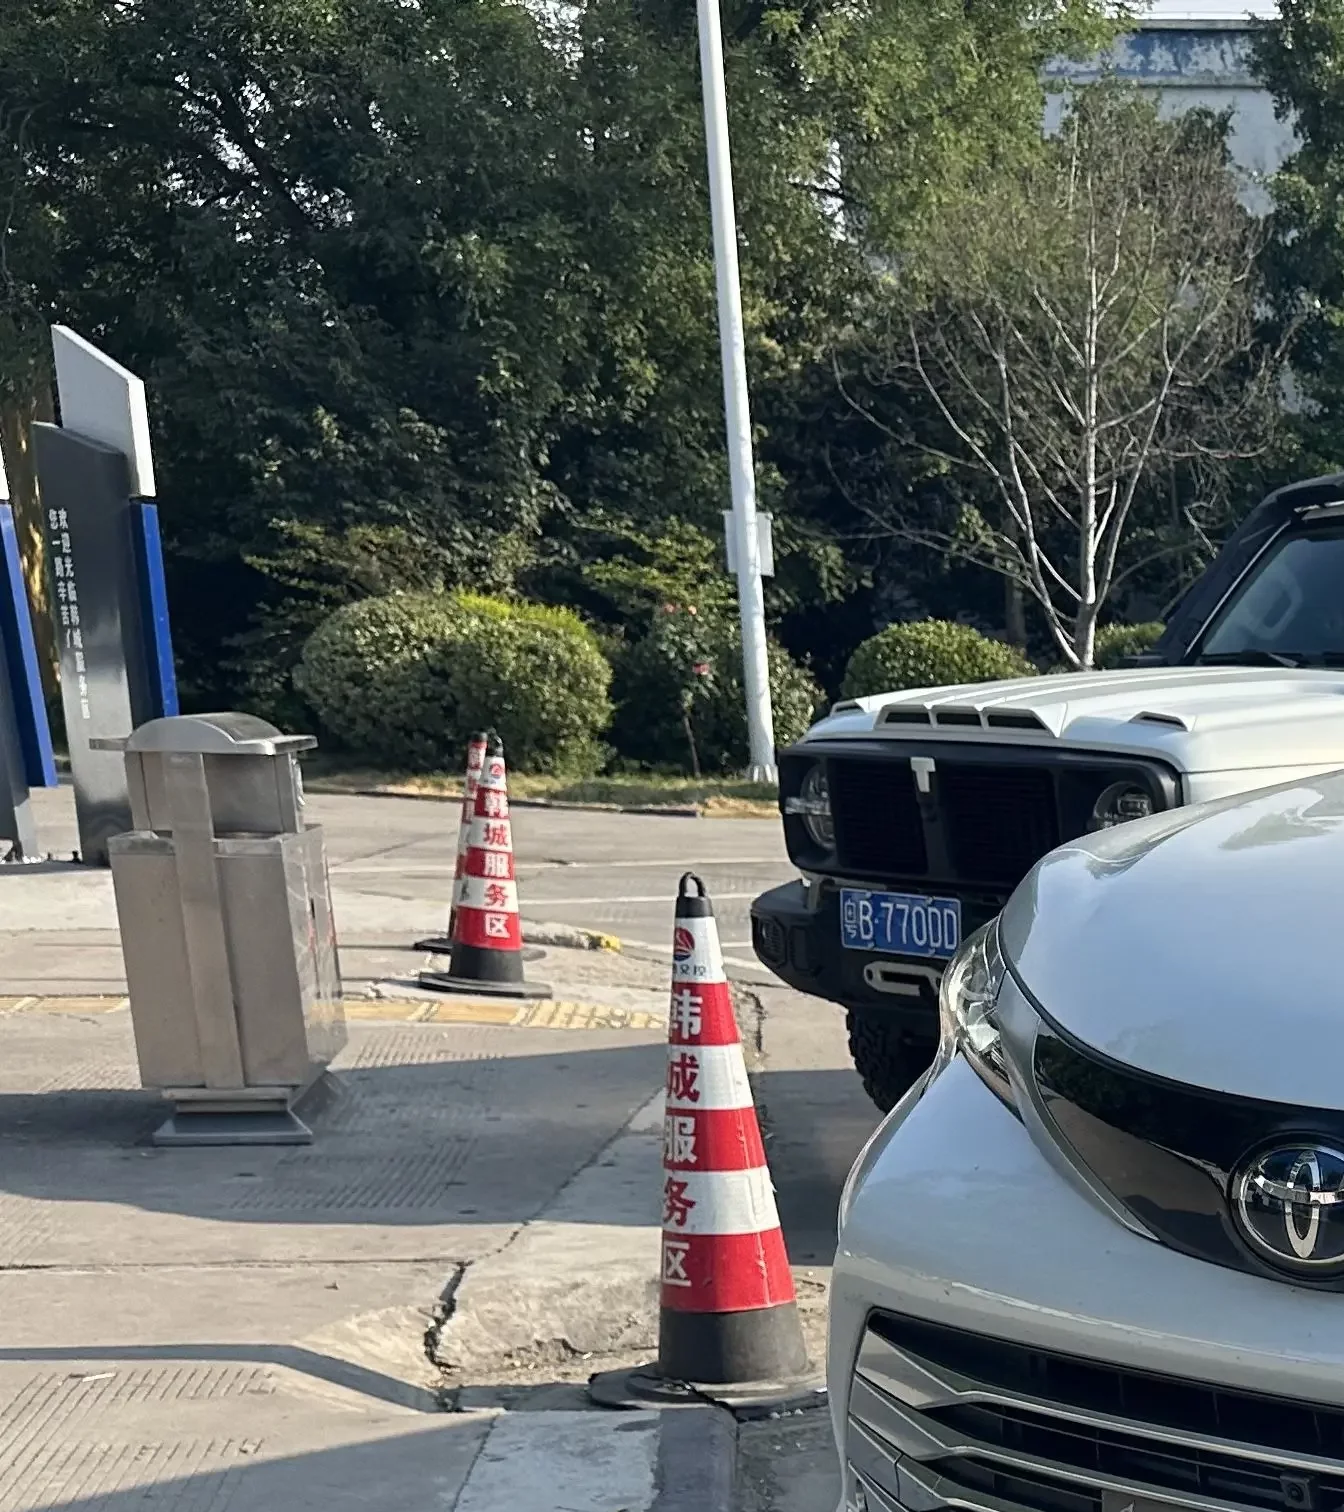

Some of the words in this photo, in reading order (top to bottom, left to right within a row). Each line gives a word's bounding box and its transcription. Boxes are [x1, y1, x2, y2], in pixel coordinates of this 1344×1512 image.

[482, 790, 511, 938] 韩城服务区
